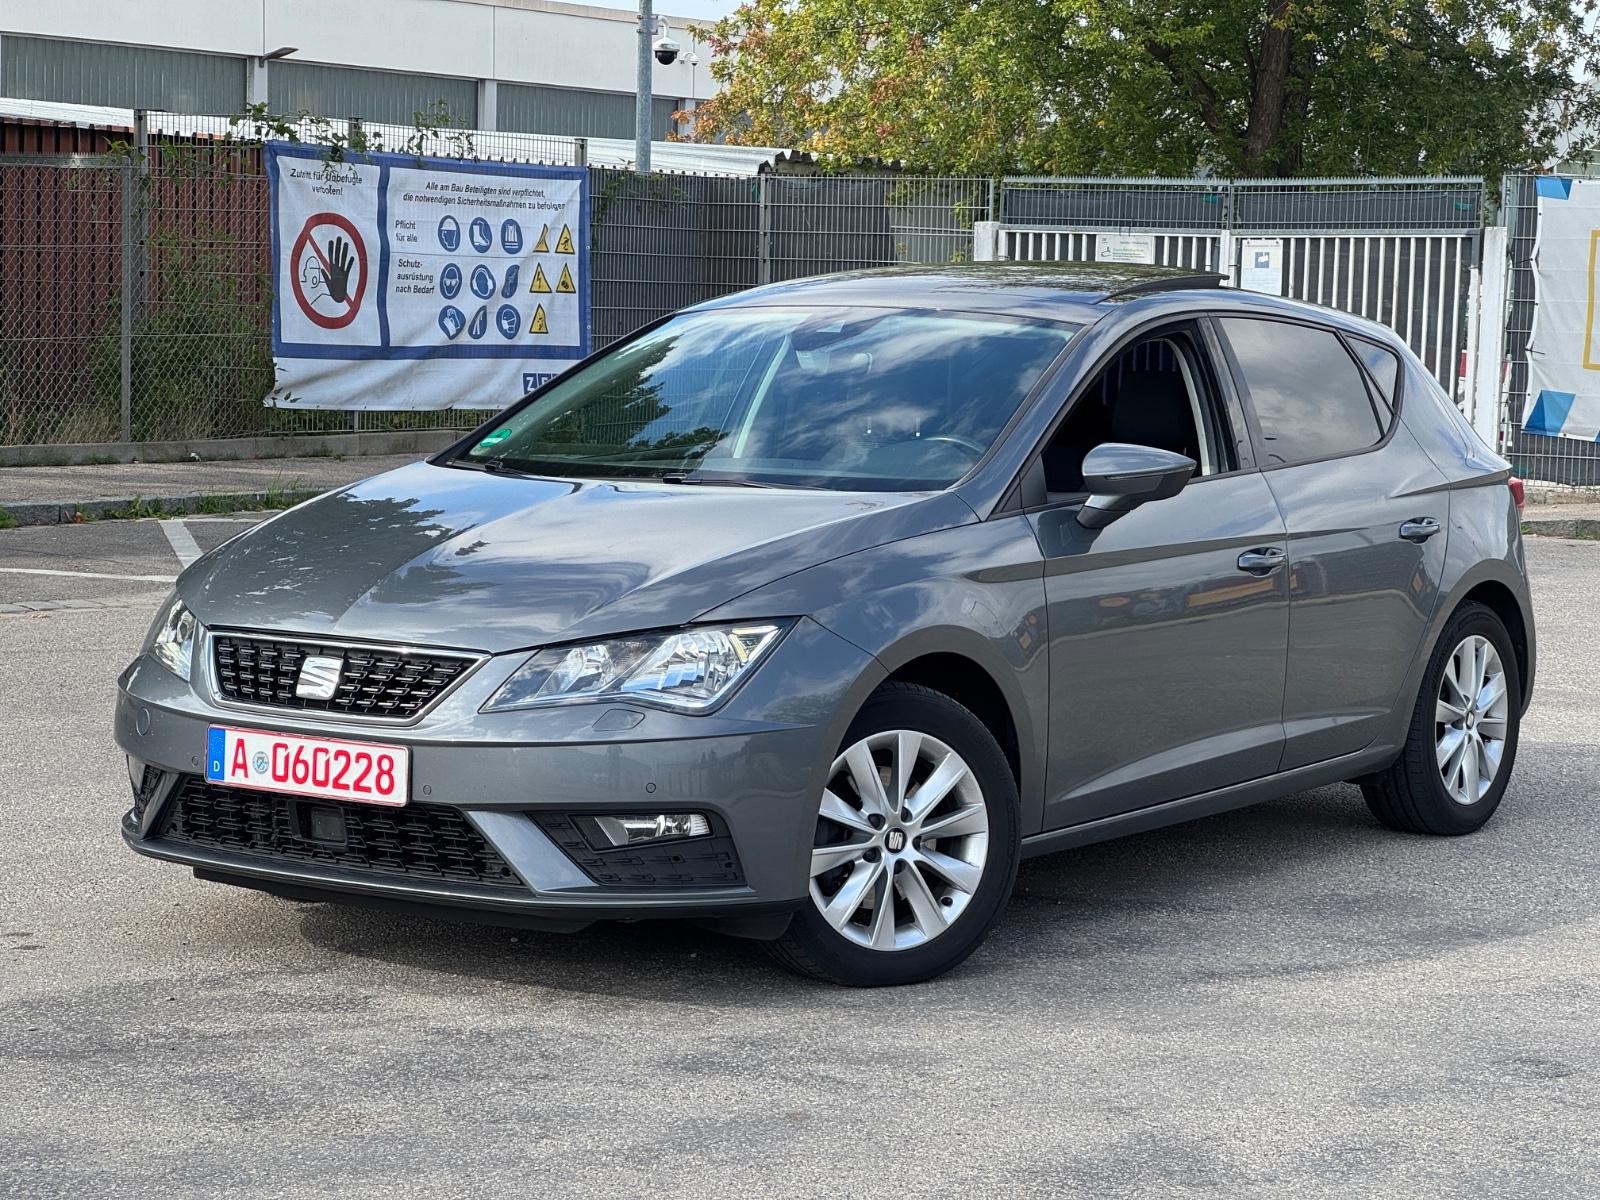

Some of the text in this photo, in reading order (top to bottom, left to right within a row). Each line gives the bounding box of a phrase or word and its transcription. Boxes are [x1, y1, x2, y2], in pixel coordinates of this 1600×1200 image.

[313, 171, 324, 181] für
[311, 184, 343, 196] verboten!
[425, 181, 439, 191] Alle
[450, 183, 464, 193] Bau
[464, 184, 498, 197] Beteiligten
[498, 187, 512, 196] sind
[512, 188, 546, 199] verpflichtet,
[402, 192, 414, 202] die
[414, 194, 456, 206] notwendigen
[456, 196, 527, 209] Sicherheitsmaßnahmen
[395, 219, 416, 230] Pflicht
[396, 233, 418, 243] für alle
[398, 258, 423, 269] Schutz-
[396, 272, 434, 284] ausrüstung
[395, 284, 435, 295] nach Bedarf
[213, 760, 221, 772] D
[231, 738, 395, 796] A 060228
